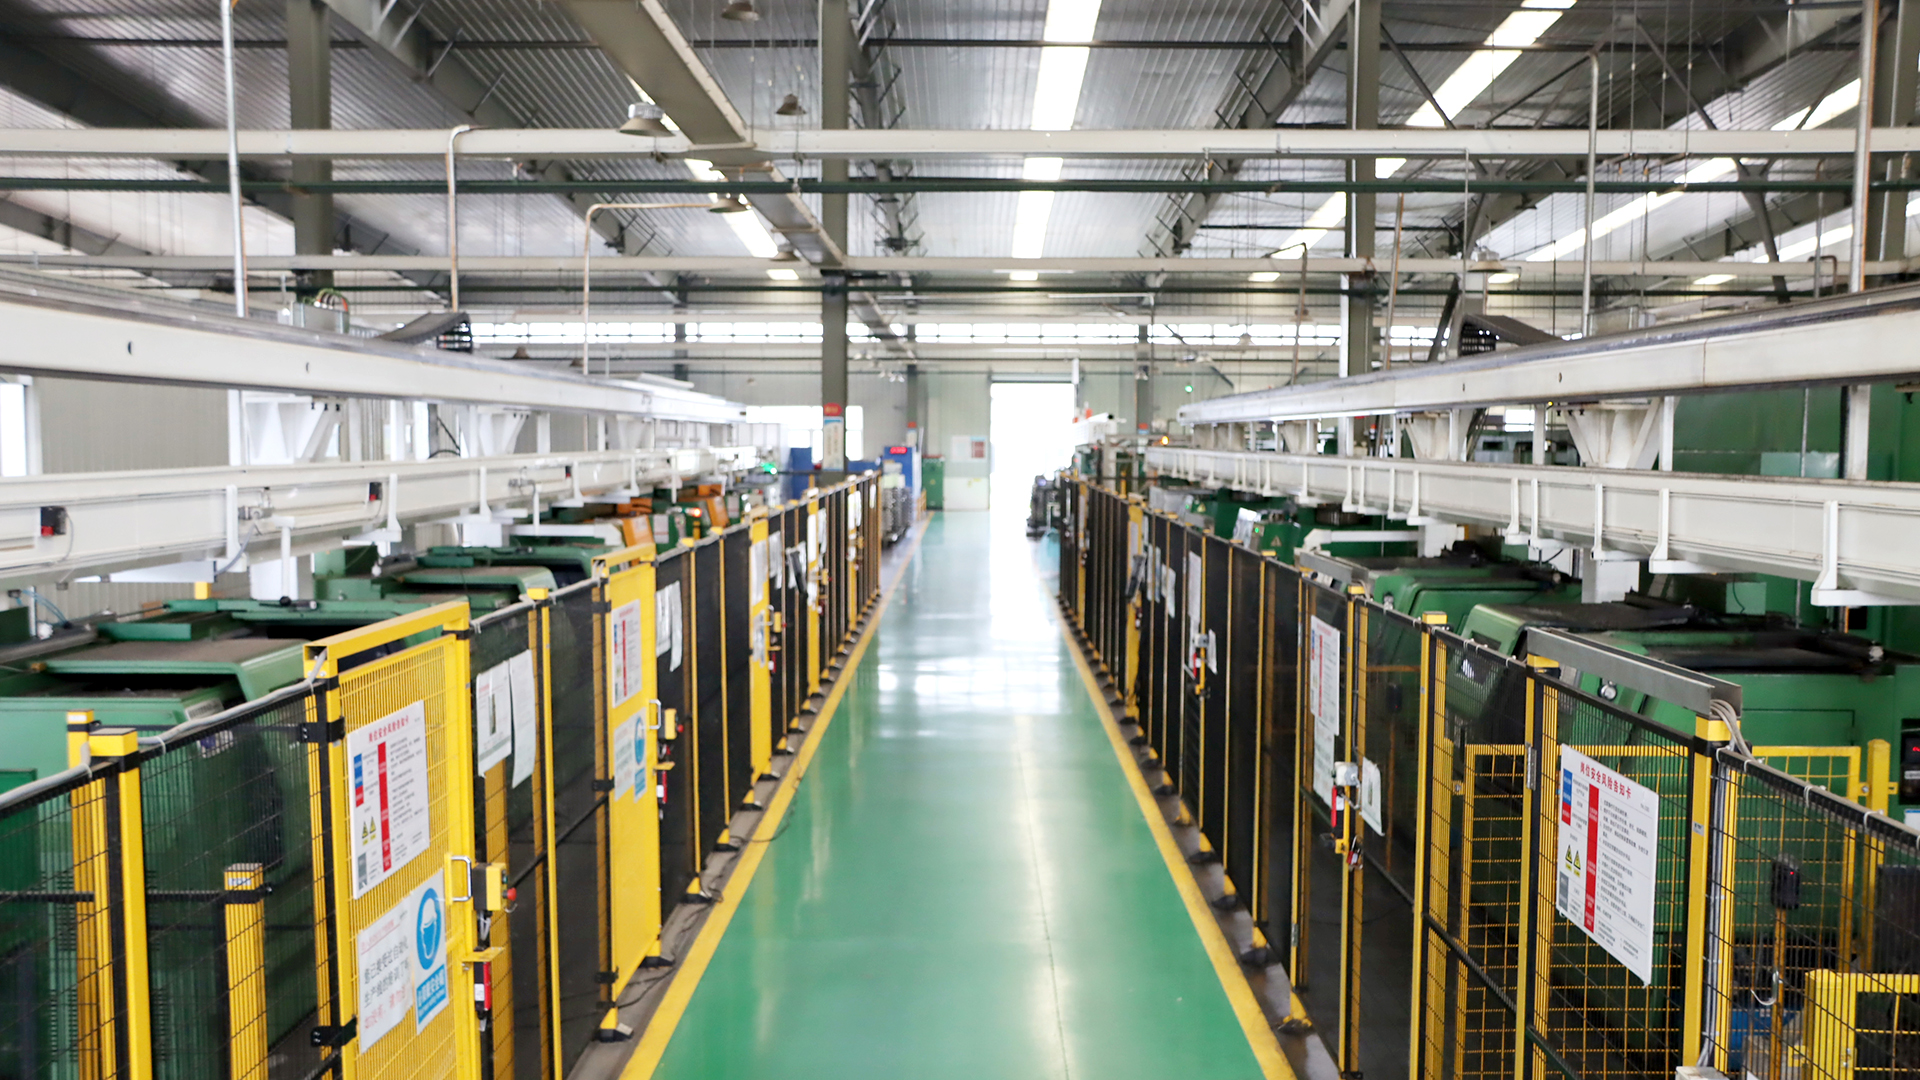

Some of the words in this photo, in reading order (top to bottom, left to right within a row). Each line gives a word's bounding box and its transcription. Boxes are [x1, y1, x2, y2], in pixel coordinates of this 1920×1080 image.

[1580, 761, 1632, 800] 岗位安全风险告知卡
